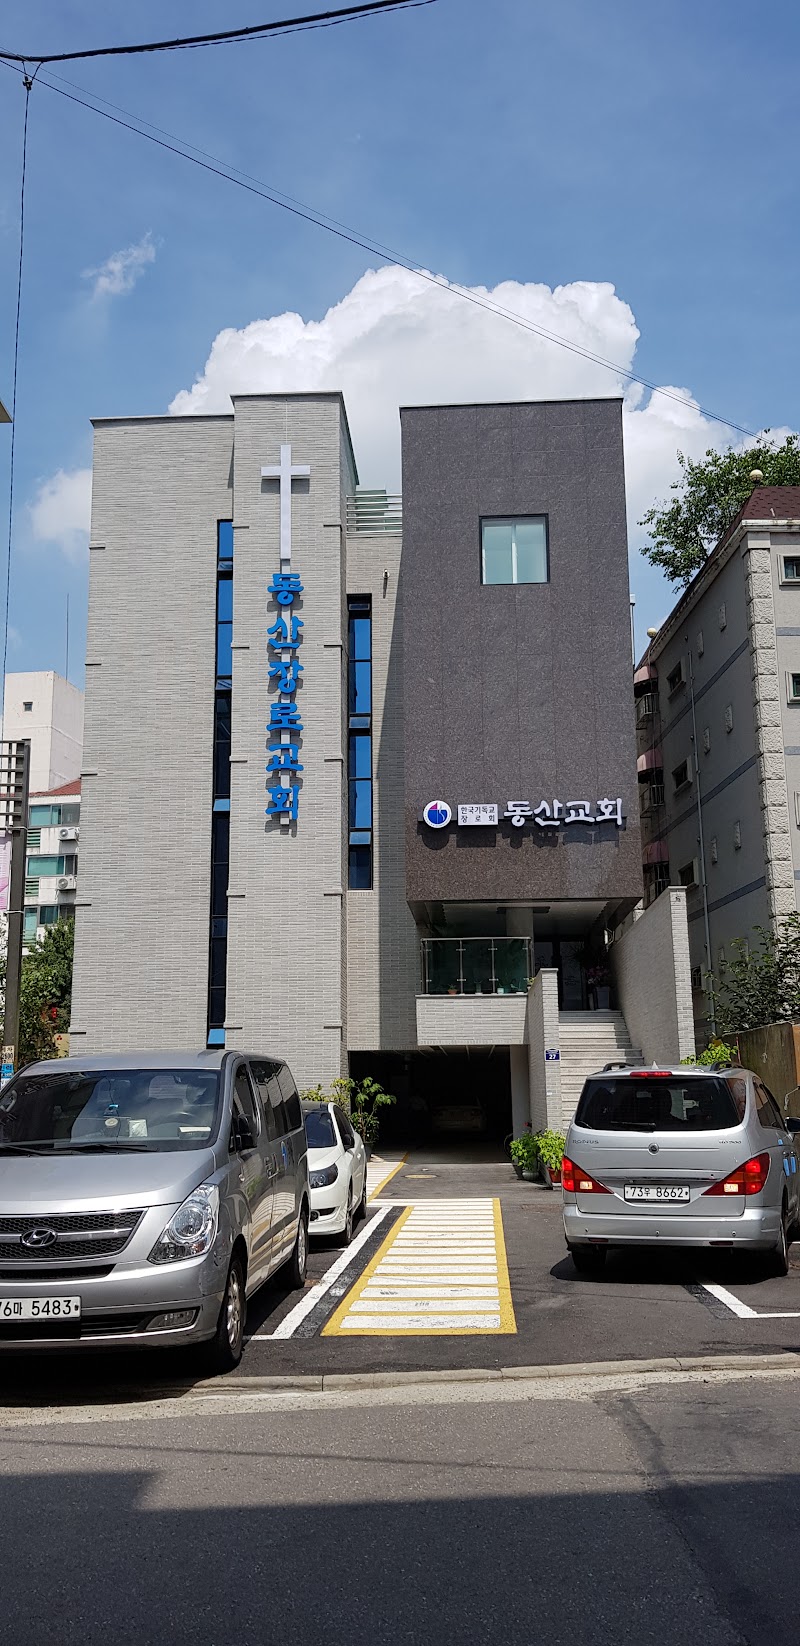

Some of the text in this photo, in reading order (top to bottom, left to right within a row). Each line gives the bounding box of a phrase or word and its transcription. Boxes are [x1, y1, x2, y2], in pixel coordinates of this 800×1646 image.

[265, 573, 304, 820] 동산장로교회
[460, 806, 496, 815] 한국기독교
[504, 798, 623, 826] 동산교회
[630, 1186, 684, 1198] 73우 8662
[31, 1299, 72, 1316] 5483
